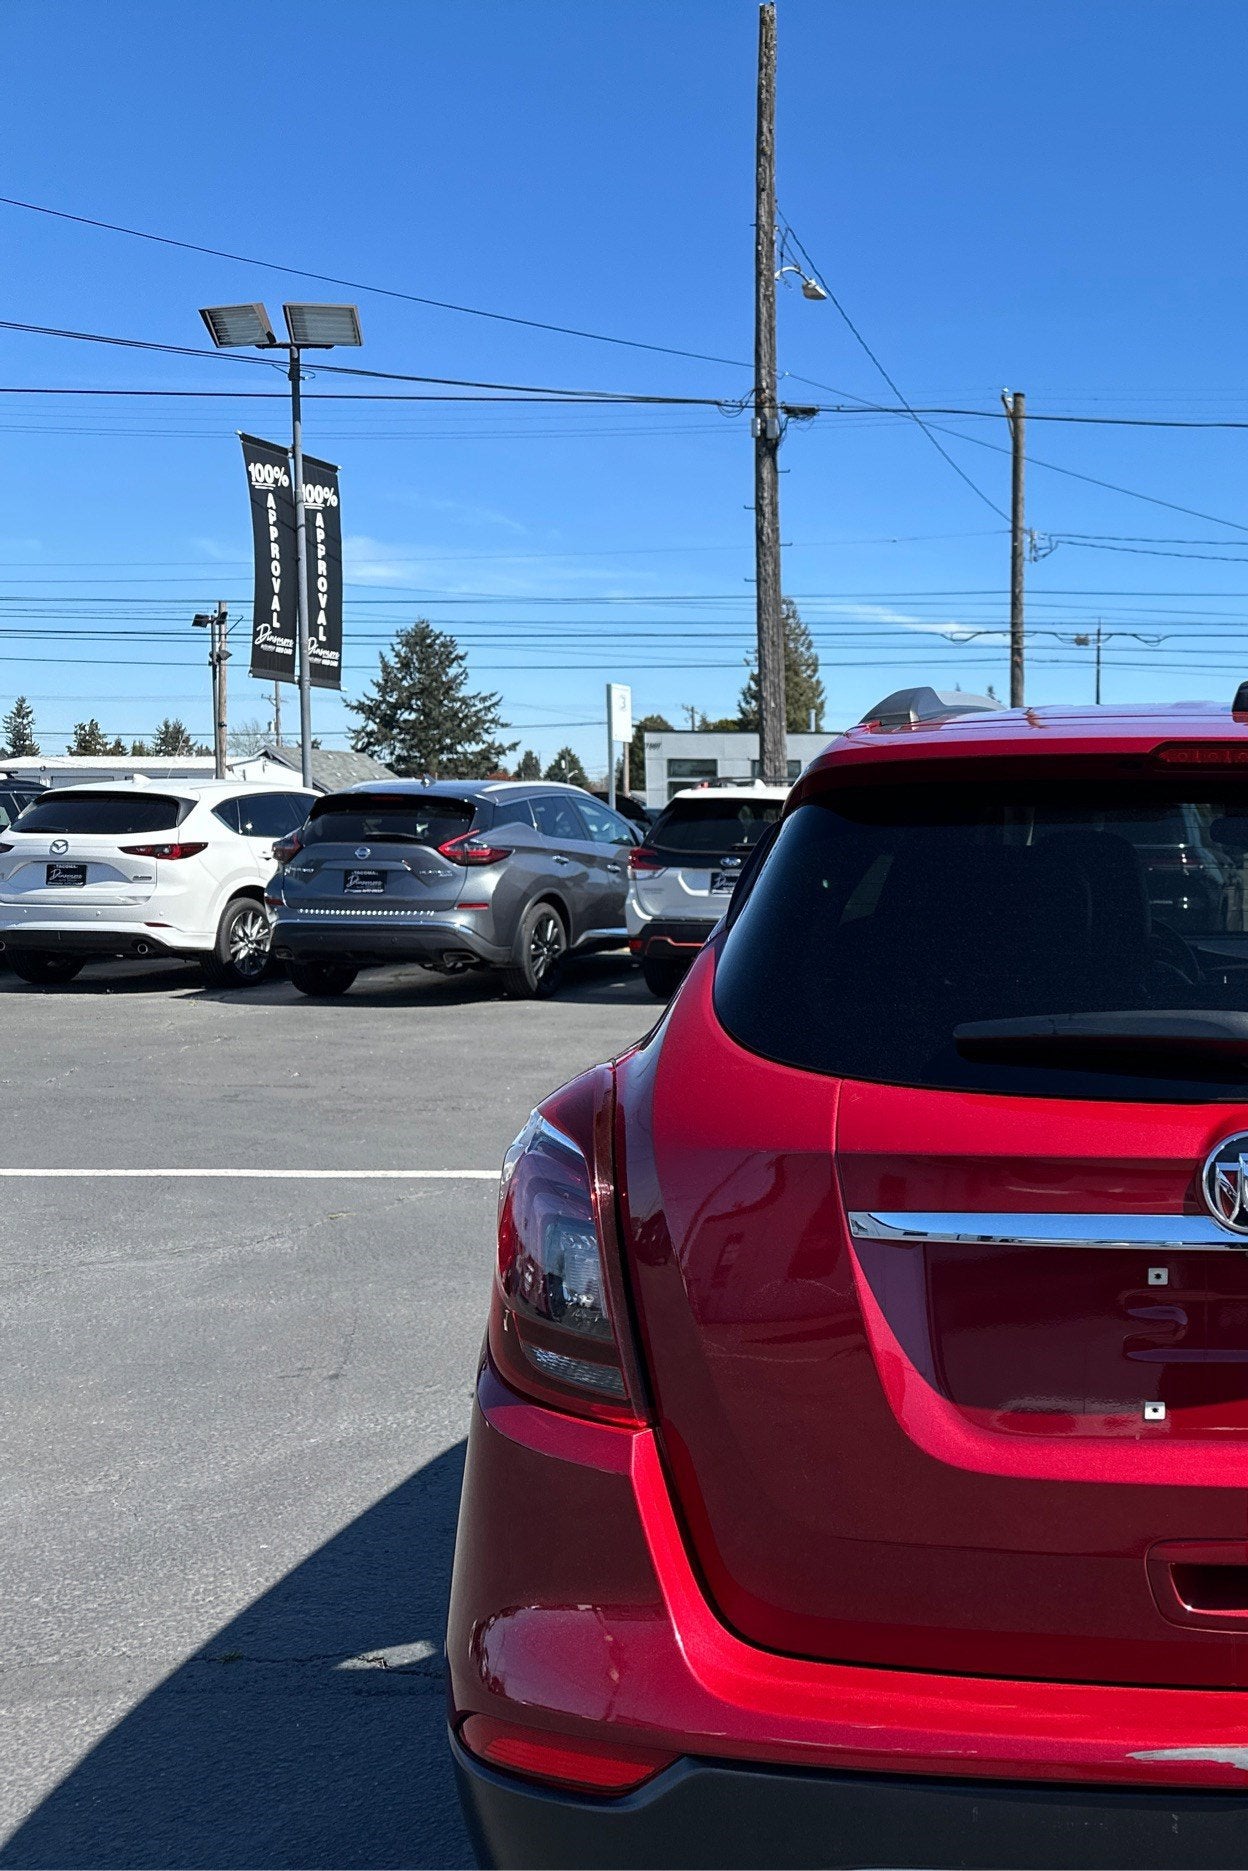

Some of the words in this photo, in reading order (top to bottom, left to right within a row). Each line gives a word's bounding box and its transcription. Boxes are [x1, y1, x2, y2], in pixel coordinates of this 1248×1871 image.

[248, 462, 290, 488] 100%
[302, 483, 338, 508] 100%
[266, 492, 281, 629] APPROVAL
[315, 512, 328, 642] APPROVAL
